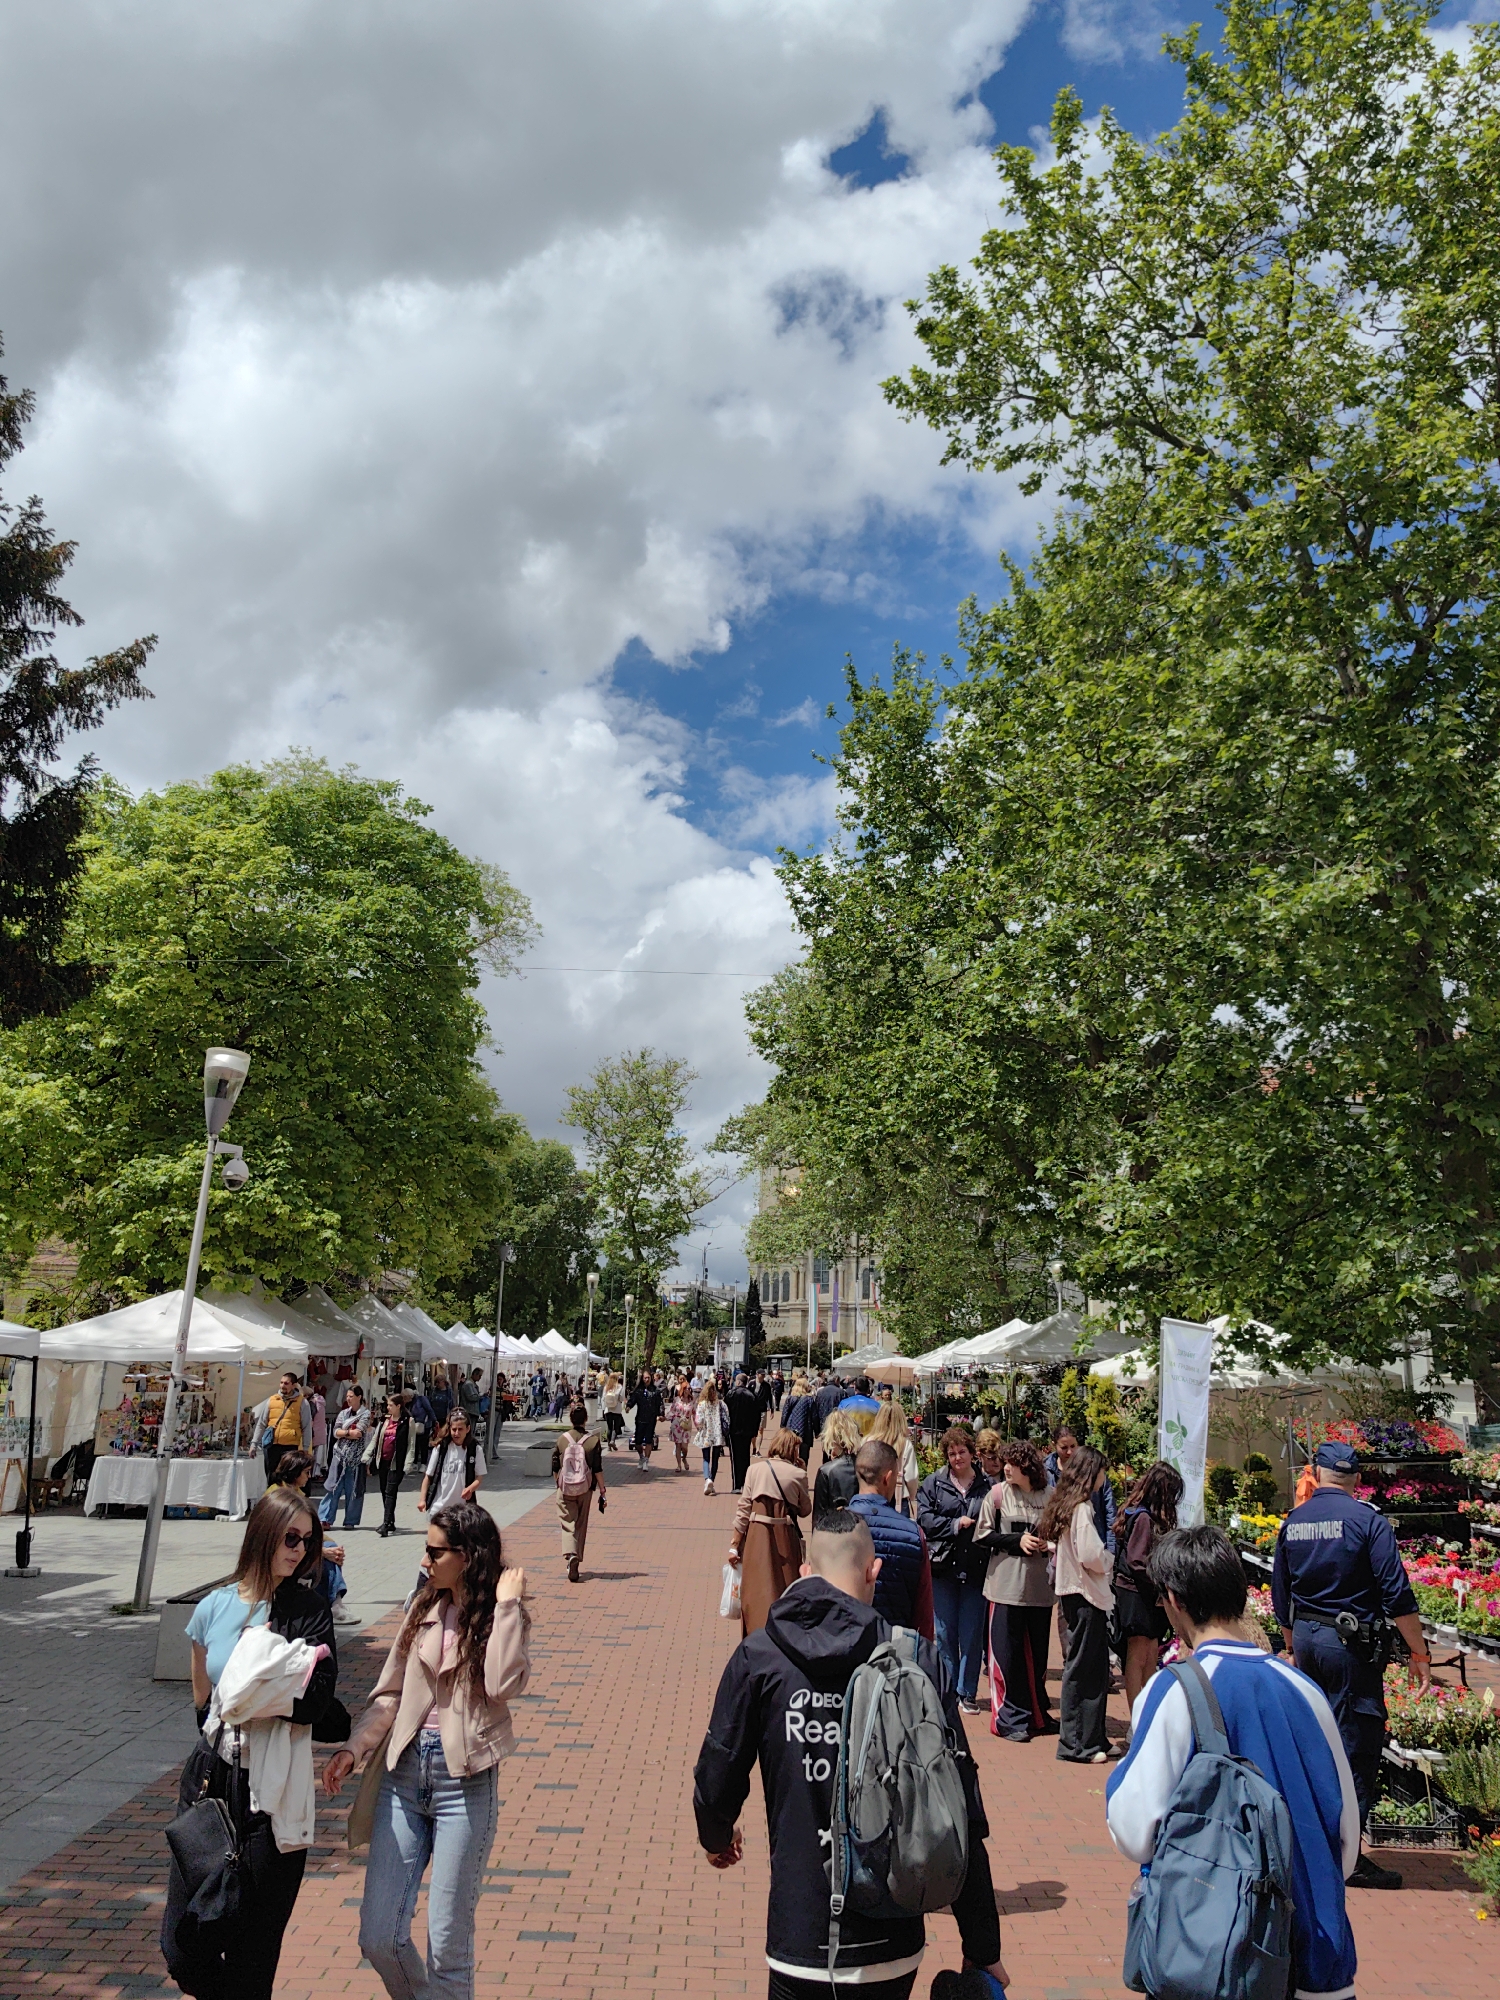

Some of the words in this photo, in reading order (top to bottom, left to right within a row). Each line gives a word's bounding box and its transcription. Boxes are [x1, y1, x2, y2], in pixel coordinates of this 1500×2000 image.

[1286, 1523, 1319, 1541] SECURITY
[1319, 1520, 1343, 1539] POLICE
[811, 1692, 844, 1708] DEC
[785, 1711, 841, 1745] Rea
[802, 1752, 831, 1782] to
